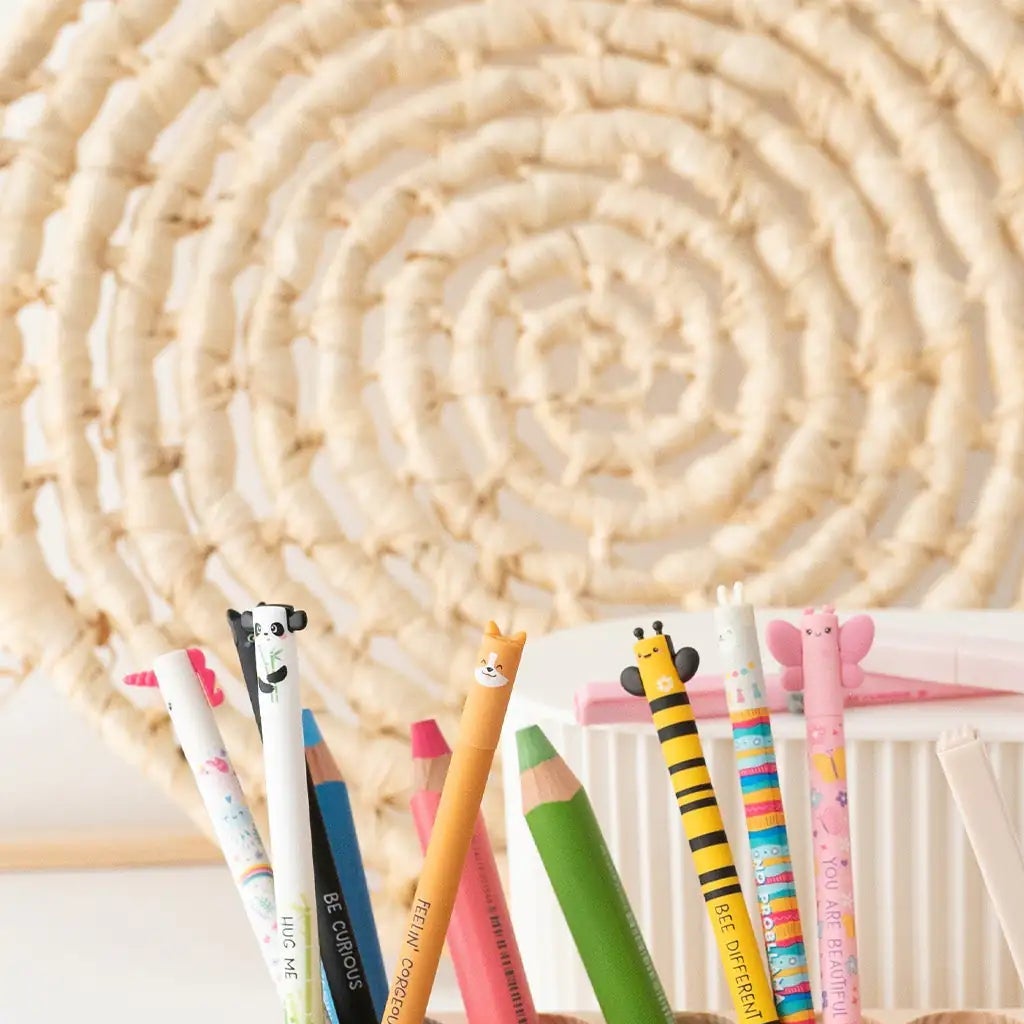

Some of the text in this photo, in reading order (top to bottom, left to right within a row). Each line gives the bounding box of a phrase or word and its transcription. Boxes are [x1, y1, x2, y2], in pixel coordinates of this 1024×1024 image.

[280, 915, 298, 980] HUG ME
[323, 892, 363, 991] BE CURIOUS
[406, 898, 431, 953] FEELIN'
[714, 903, 763, 1020] BEE DIFFERENT
[822, 856, 848, 1018] YOU ARE BEAUTIFUL
